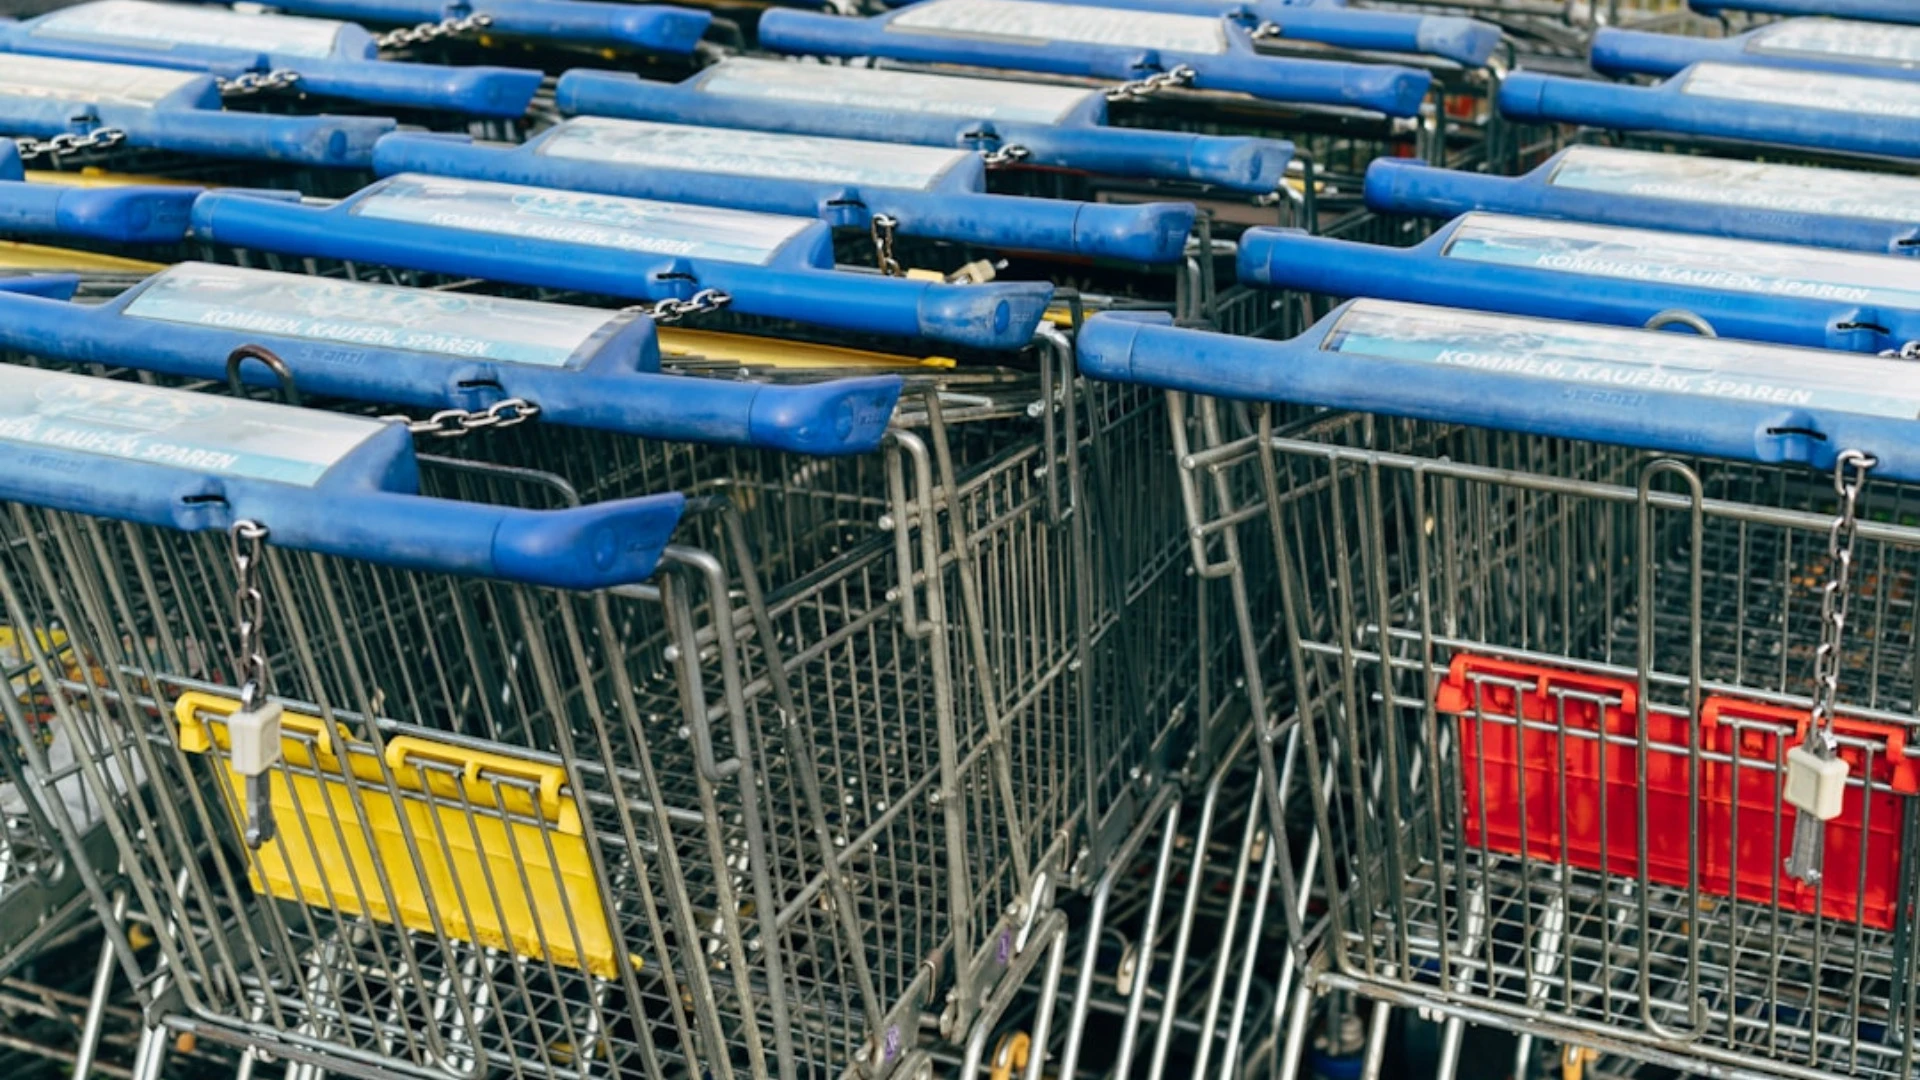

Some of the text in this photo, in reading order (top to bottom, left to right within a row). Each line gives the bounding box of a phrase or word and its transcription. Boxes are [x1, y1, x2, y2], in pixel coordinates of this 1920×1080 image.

[1534, 253, 1651, 280] KOMMEN,
[1770, 278, 1870, 300] SPAREN
[200, 310, 491, 354] KOMMEN, KAUFEN, SPAREN
[1435, 348, 1814, 406] KOMMEN, KAUFEN, SPAREN
[42, 426, 138, 457] KAUFEN,
[142, 443, 238, 468] SPAREN
